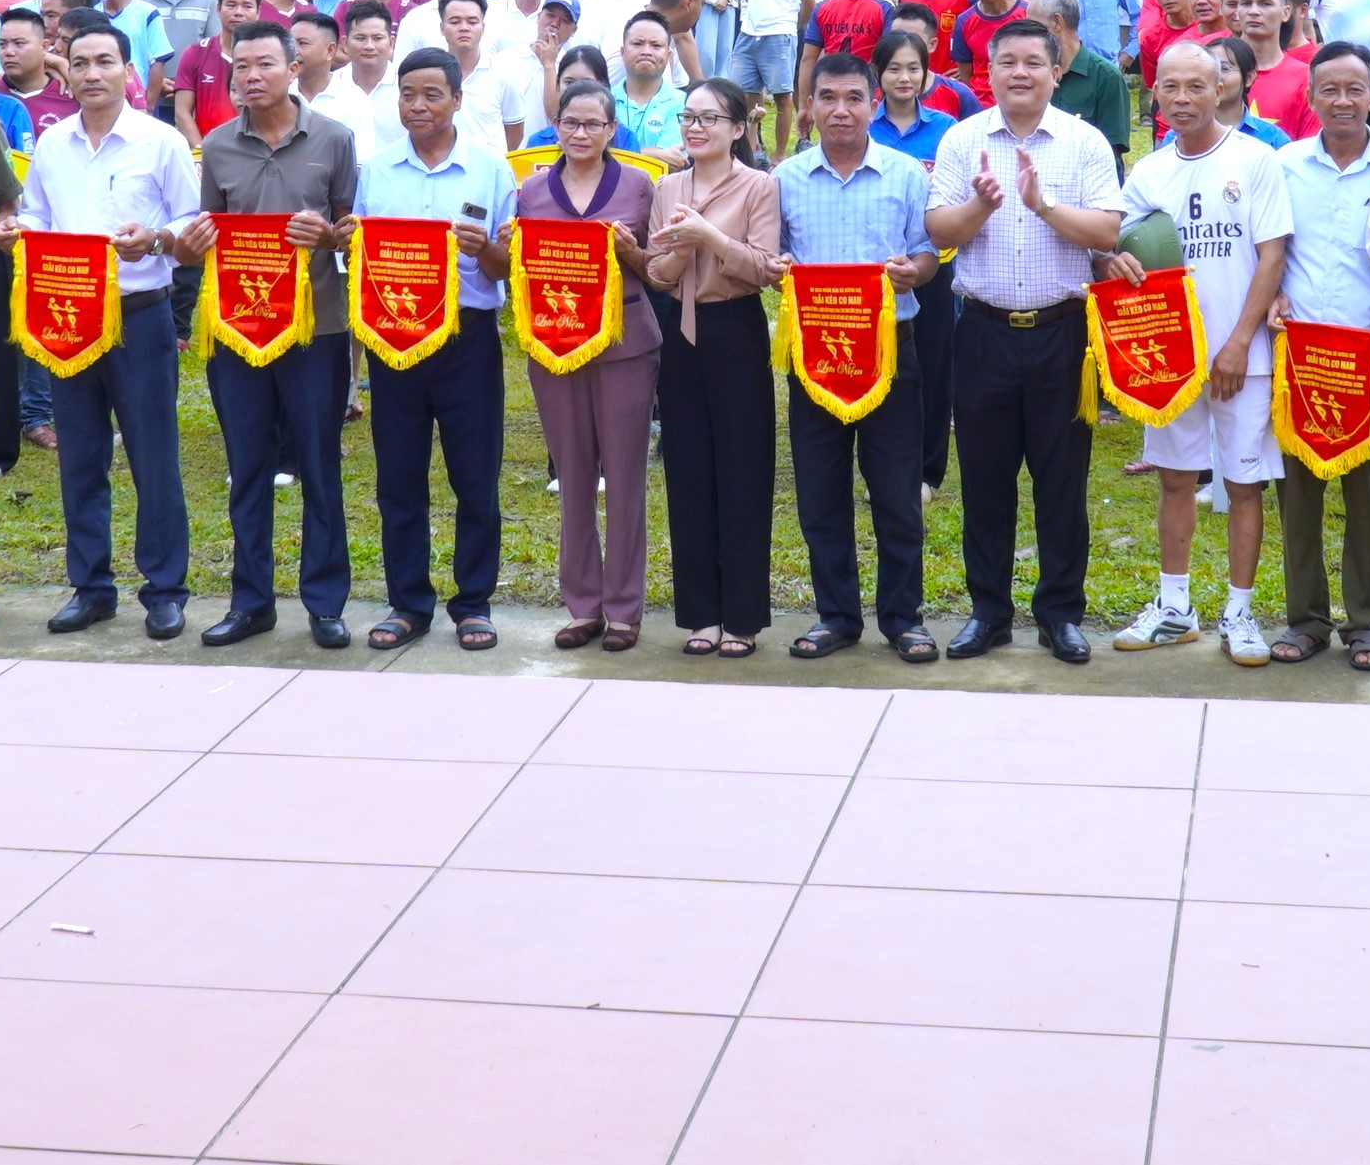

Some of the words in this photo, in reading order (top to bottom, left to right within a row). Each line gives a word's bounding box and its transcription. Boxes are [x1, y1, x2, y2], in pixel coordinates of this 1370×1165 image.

[1189, 192, 1202, 220] 6
[1178, 220, 1243, 240] mirates
[1188, 241, 1232, 259] BETTER
